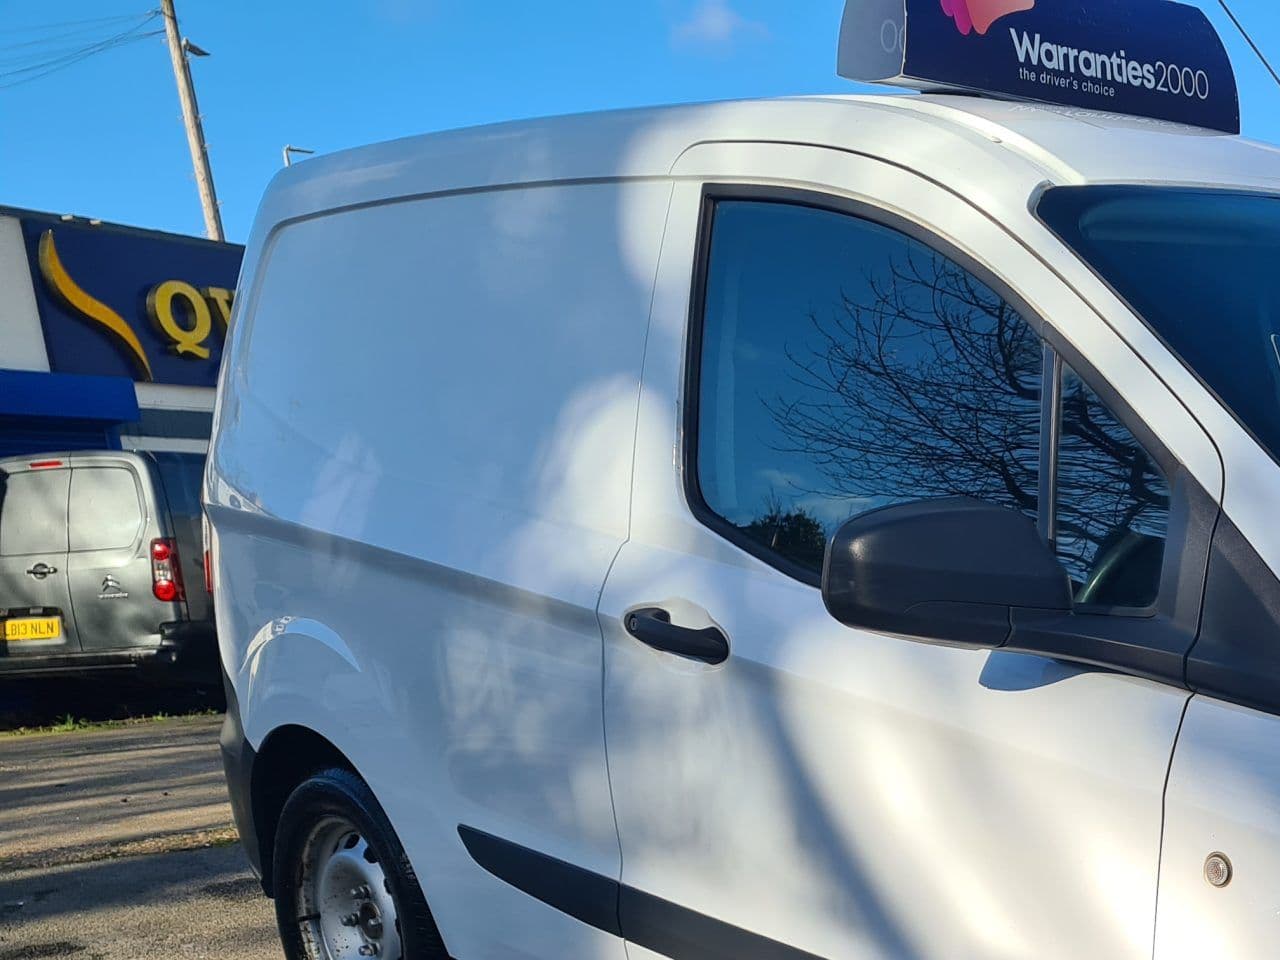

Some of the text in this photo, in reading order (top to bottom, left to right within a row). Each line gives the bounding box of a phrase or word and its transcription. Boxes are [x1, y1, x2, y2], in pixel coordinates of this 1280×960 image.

[1009, 27, 1209, 100] Warranties2000
[1019, 67, 1115, 97] the driver's choice
[31, 622, 54, 635] NLN
